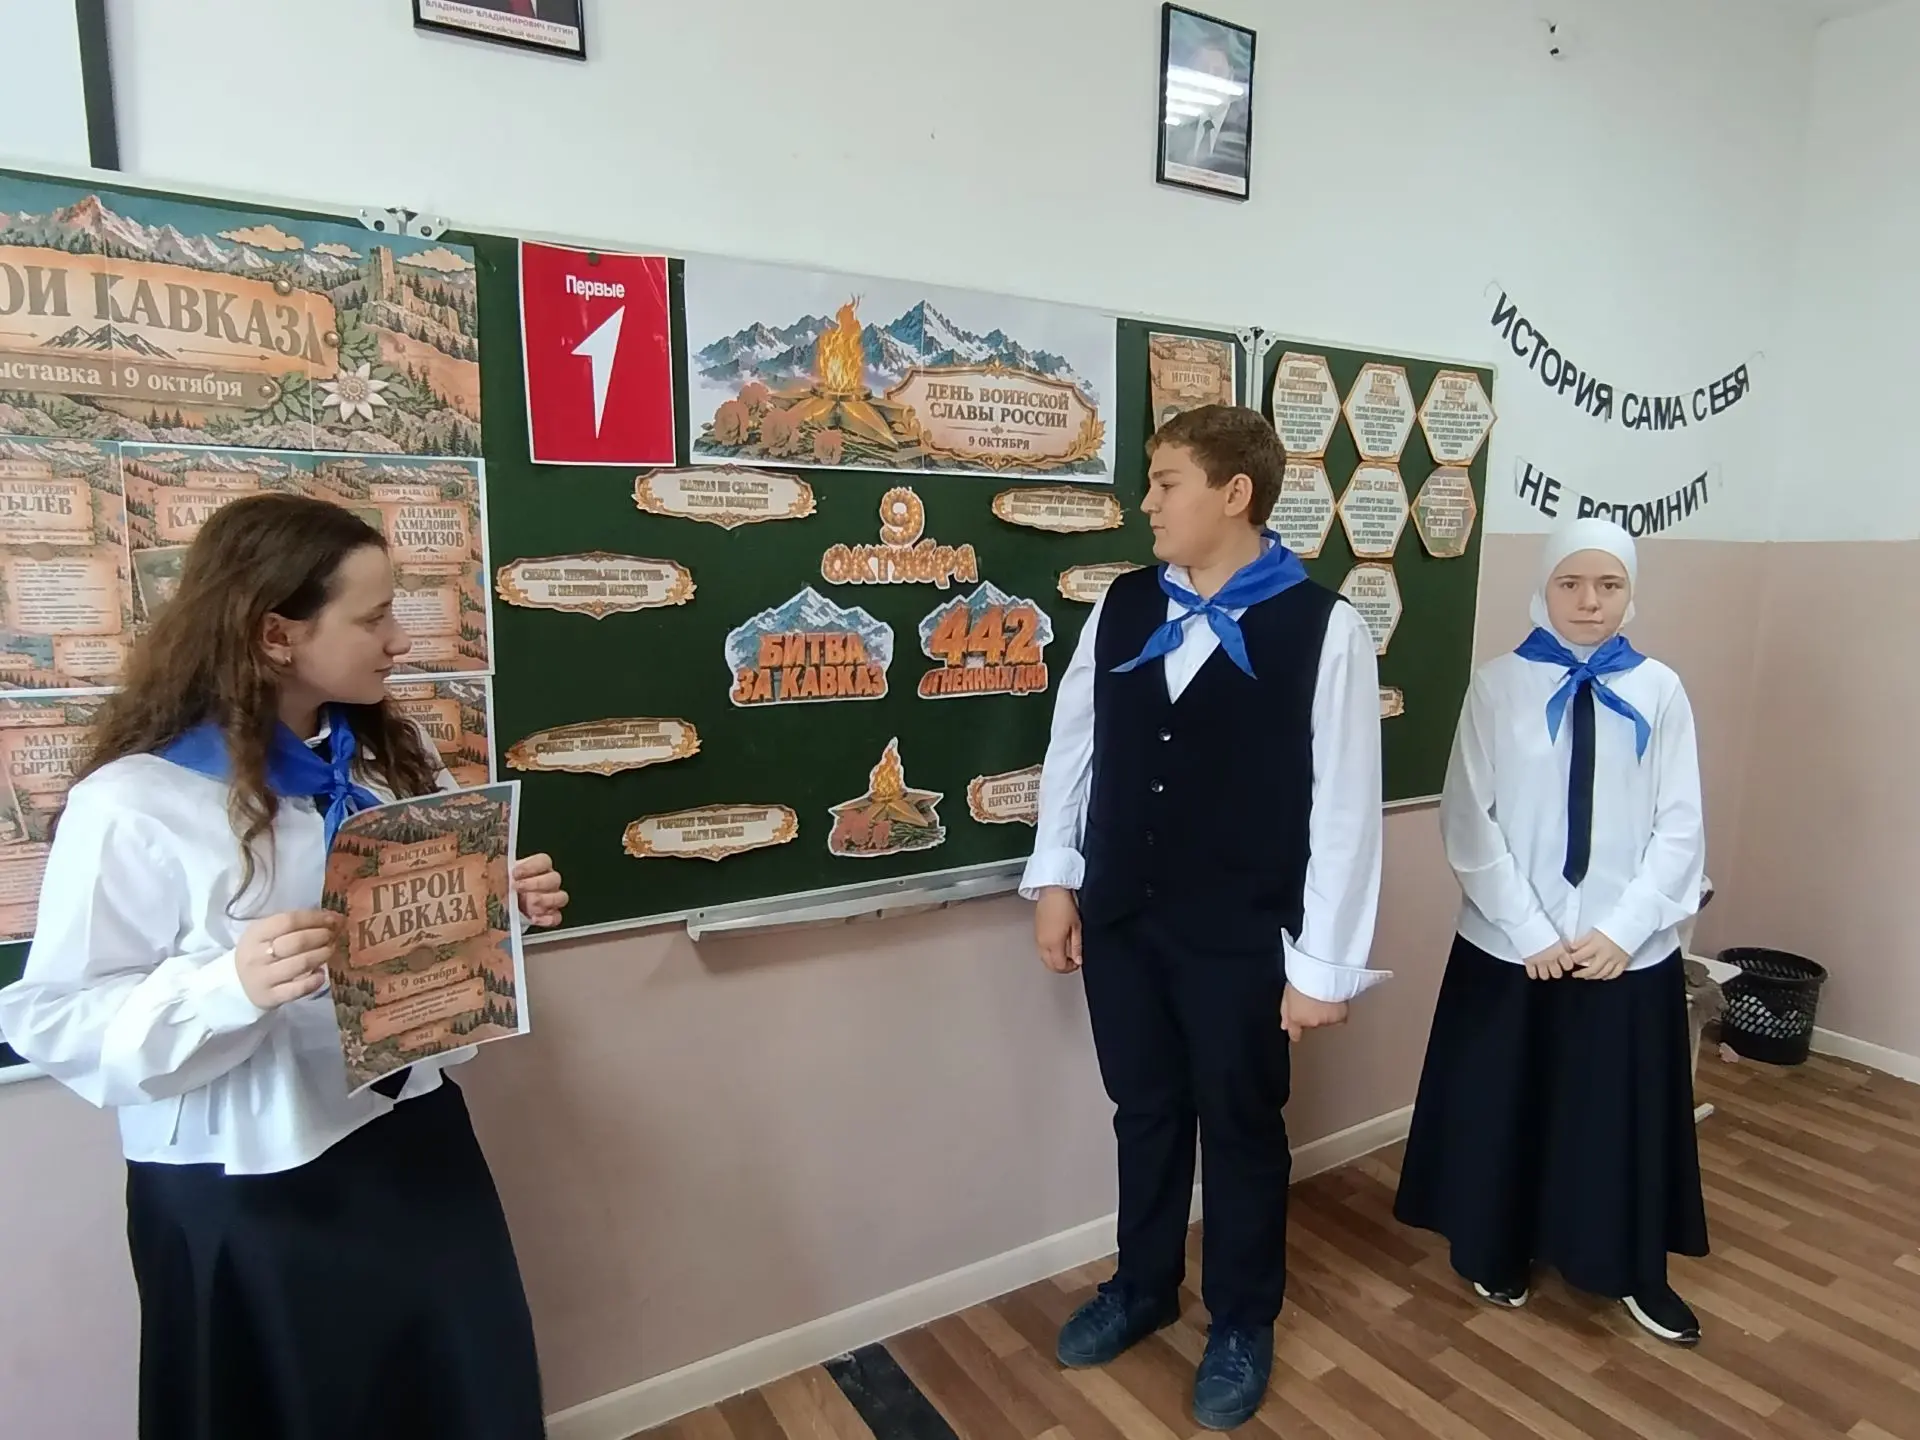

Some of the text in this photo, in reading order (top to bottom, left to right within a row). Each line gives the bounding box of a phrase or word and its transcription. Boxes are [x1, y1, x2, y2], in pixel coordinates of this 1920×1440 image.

[565, 274, 625, 301] Первые
[91, 272, 326, 366] КАВКАЗА
[1490, 291, 1750, 431] ИСТОРИЯ САМА СЕБЯ
[124, 367, 139, 387] 9
[147, 373, 243, 400] октября
[926, 383, 1070, 411] ДЕНЬ ВОИНСКОЙ
[929, 402, 1068, 429] СЛАВЫ РОССИИ
[968, 436, 1030, 450] 9 ОКТЯБРЯ
[1518, 463, 1562, 518] НЕ
[881, 488, 924, 546] 9
[393, 531, 464, 547] АЧМИЗОВ
[759, 632, 866, 667] БИТВА
[930, 604, 1041, 669] 442
[733, 664, 885, 702] ЗА КАВКАЗ
[920, 667, 1014, 696] ОГНЕННЫХ
[988, 792, 1038, 807] НИЧТО НЕ
[991, 782, 1025, 795] НИКТО
[390, 844, 448, 865] ВЫСТАВКА
[371, 867, 466, 915] ГЕРОИ
[357, 893, 479, 951] КАВКАЗА
[400, 976, 409, 988] 9
[412, 964, 459, 986] октября
